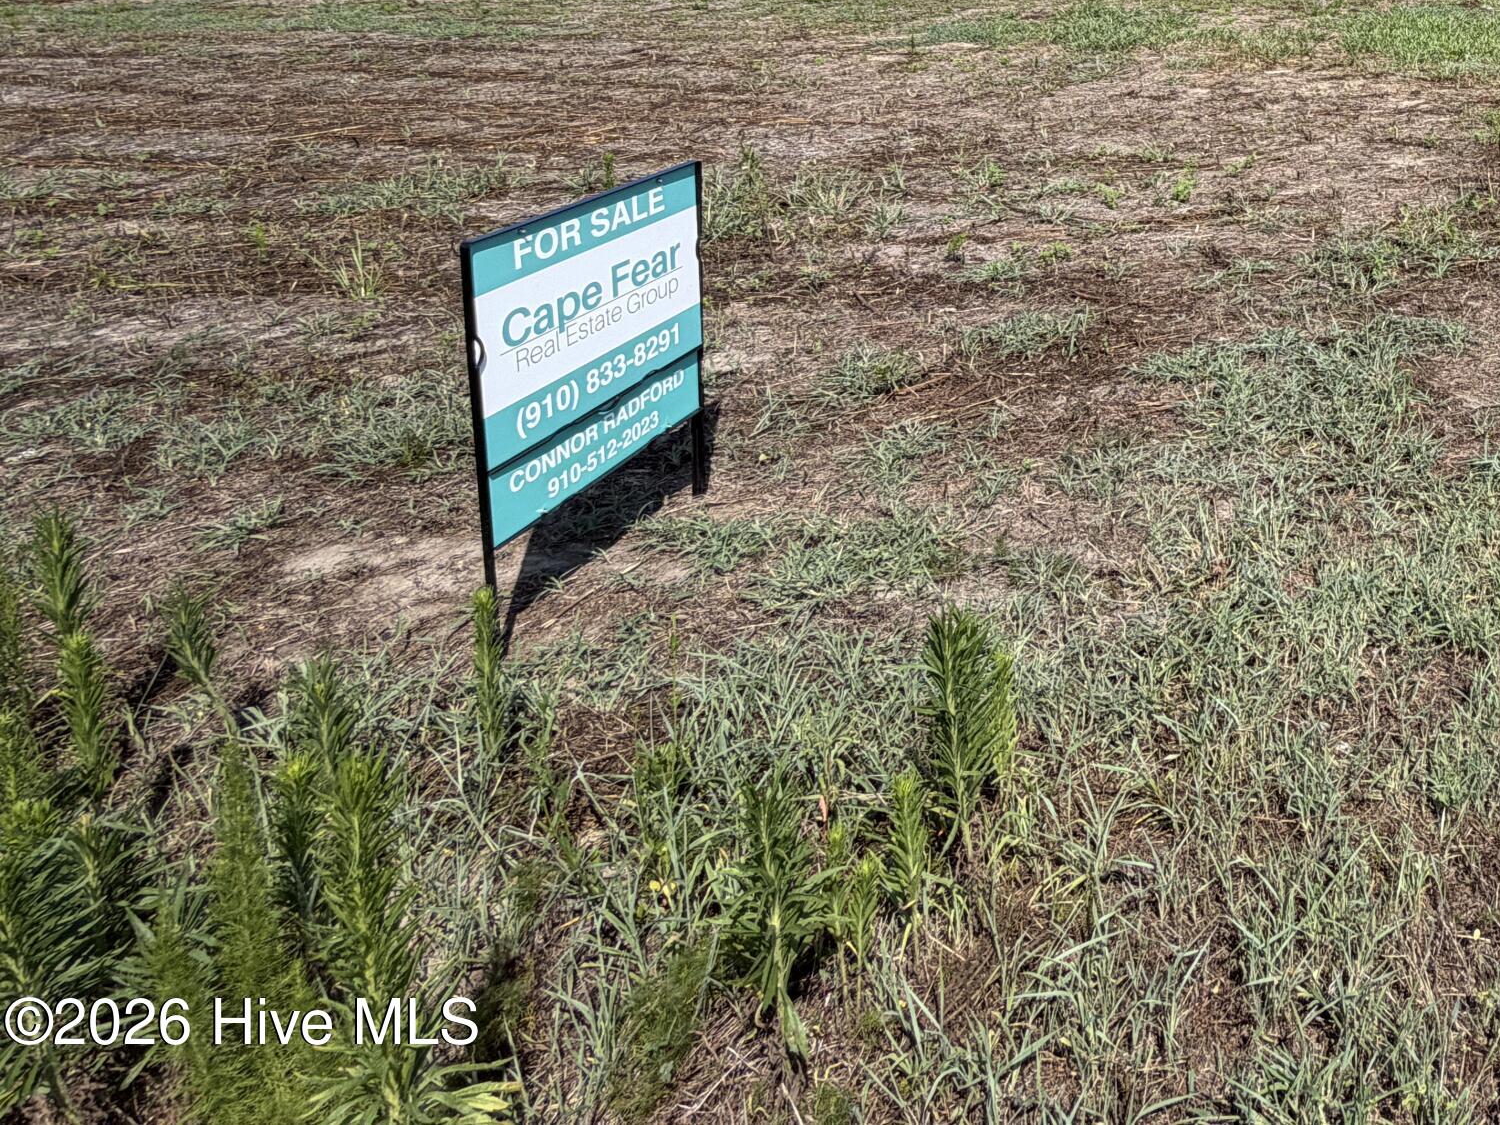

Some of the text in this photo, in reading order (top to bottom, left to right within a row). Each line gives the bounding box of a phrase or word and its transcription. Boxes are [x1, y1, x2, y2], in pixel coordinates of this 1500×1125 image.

[513, 186, 666, 270] FOR SALE
[502, 242, 681, 347] Cape Fear
[516, 275, 679, 373] Real Estate Group
[509, 369, 685, 494] CONNOR RADFORD
[516, 323, 681, 439] (910) 833-8291
[547, 411, 660, 499] 910-512-2023
